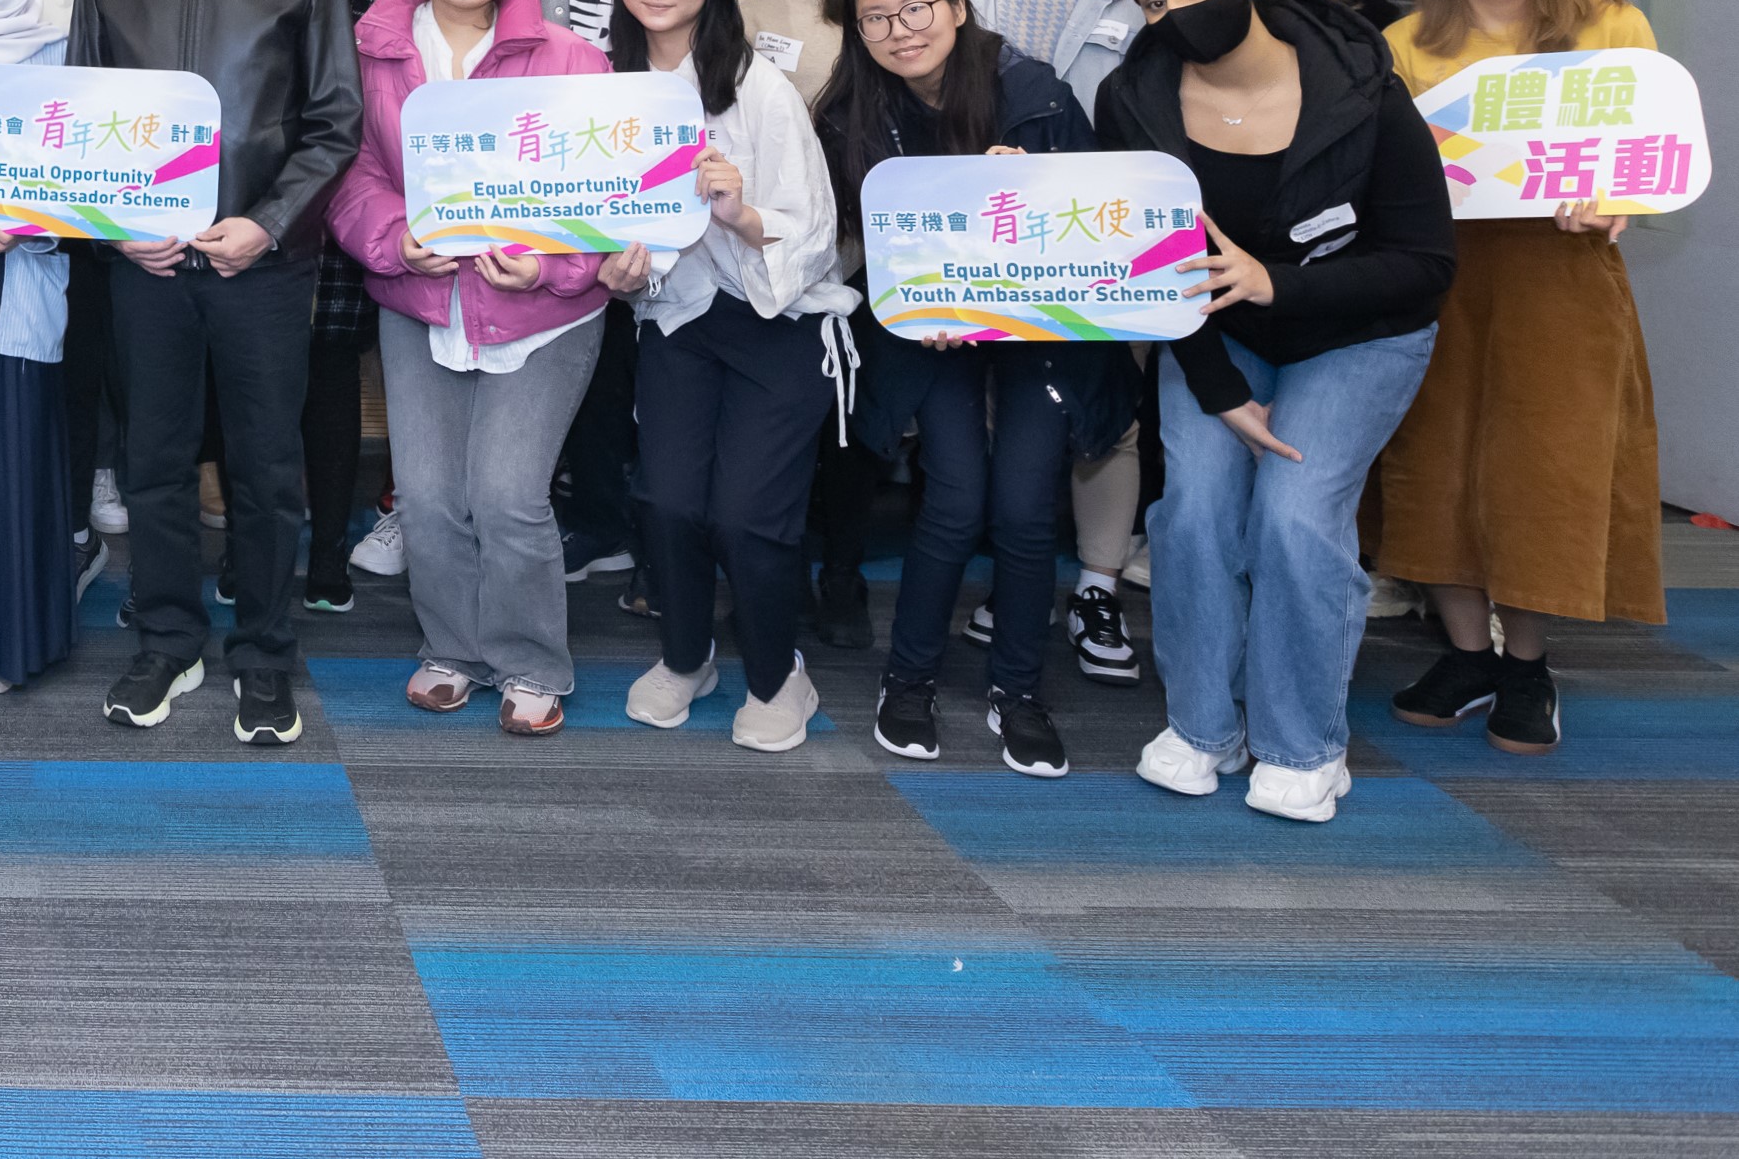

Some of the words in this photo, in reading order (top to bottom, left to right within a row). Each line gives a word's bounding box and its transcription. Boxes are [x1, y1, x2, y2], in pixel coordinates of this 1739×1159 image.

[1471, 65, 1638, 133] 體驗
[34, 101, 161, 159] 青年大使
[171, 124, 213, 145] 計劃
[708, 130, 717, 140] E
[409, 132, 497, 154] 平等機會
[508, 112, 644, 172] 青年大使
[653, 124, 697, 146] 計劃
[50, 166, 153, 187] Opportunity
[1520, 134, 1693, 200] 活動
[11, 186, 117, 204] Ambassador
[122, 192, 190, 208] Scheme
[474, 181, 525, 199] Equal
[530, 176, 640, 198] Opportunity
[435, 203, 485, 221] Youth
[491, 200, 604, 219] Ambassador
[609, 197, 682, 215] Scheme
[870, 211, 968, 233] 平等機會
[980, 191, 1134, 254] 青年大使
[1143, 208, 1196, 230] 計劃
[944, 263, 1000, 281] Equal
[1006, 262, 1129, 283] Opportunity
[901, 287, 956, 303] Youth
[963, 287, 1089, 302] Ambassador
[1096, 286, 1178, 301] Scheme
